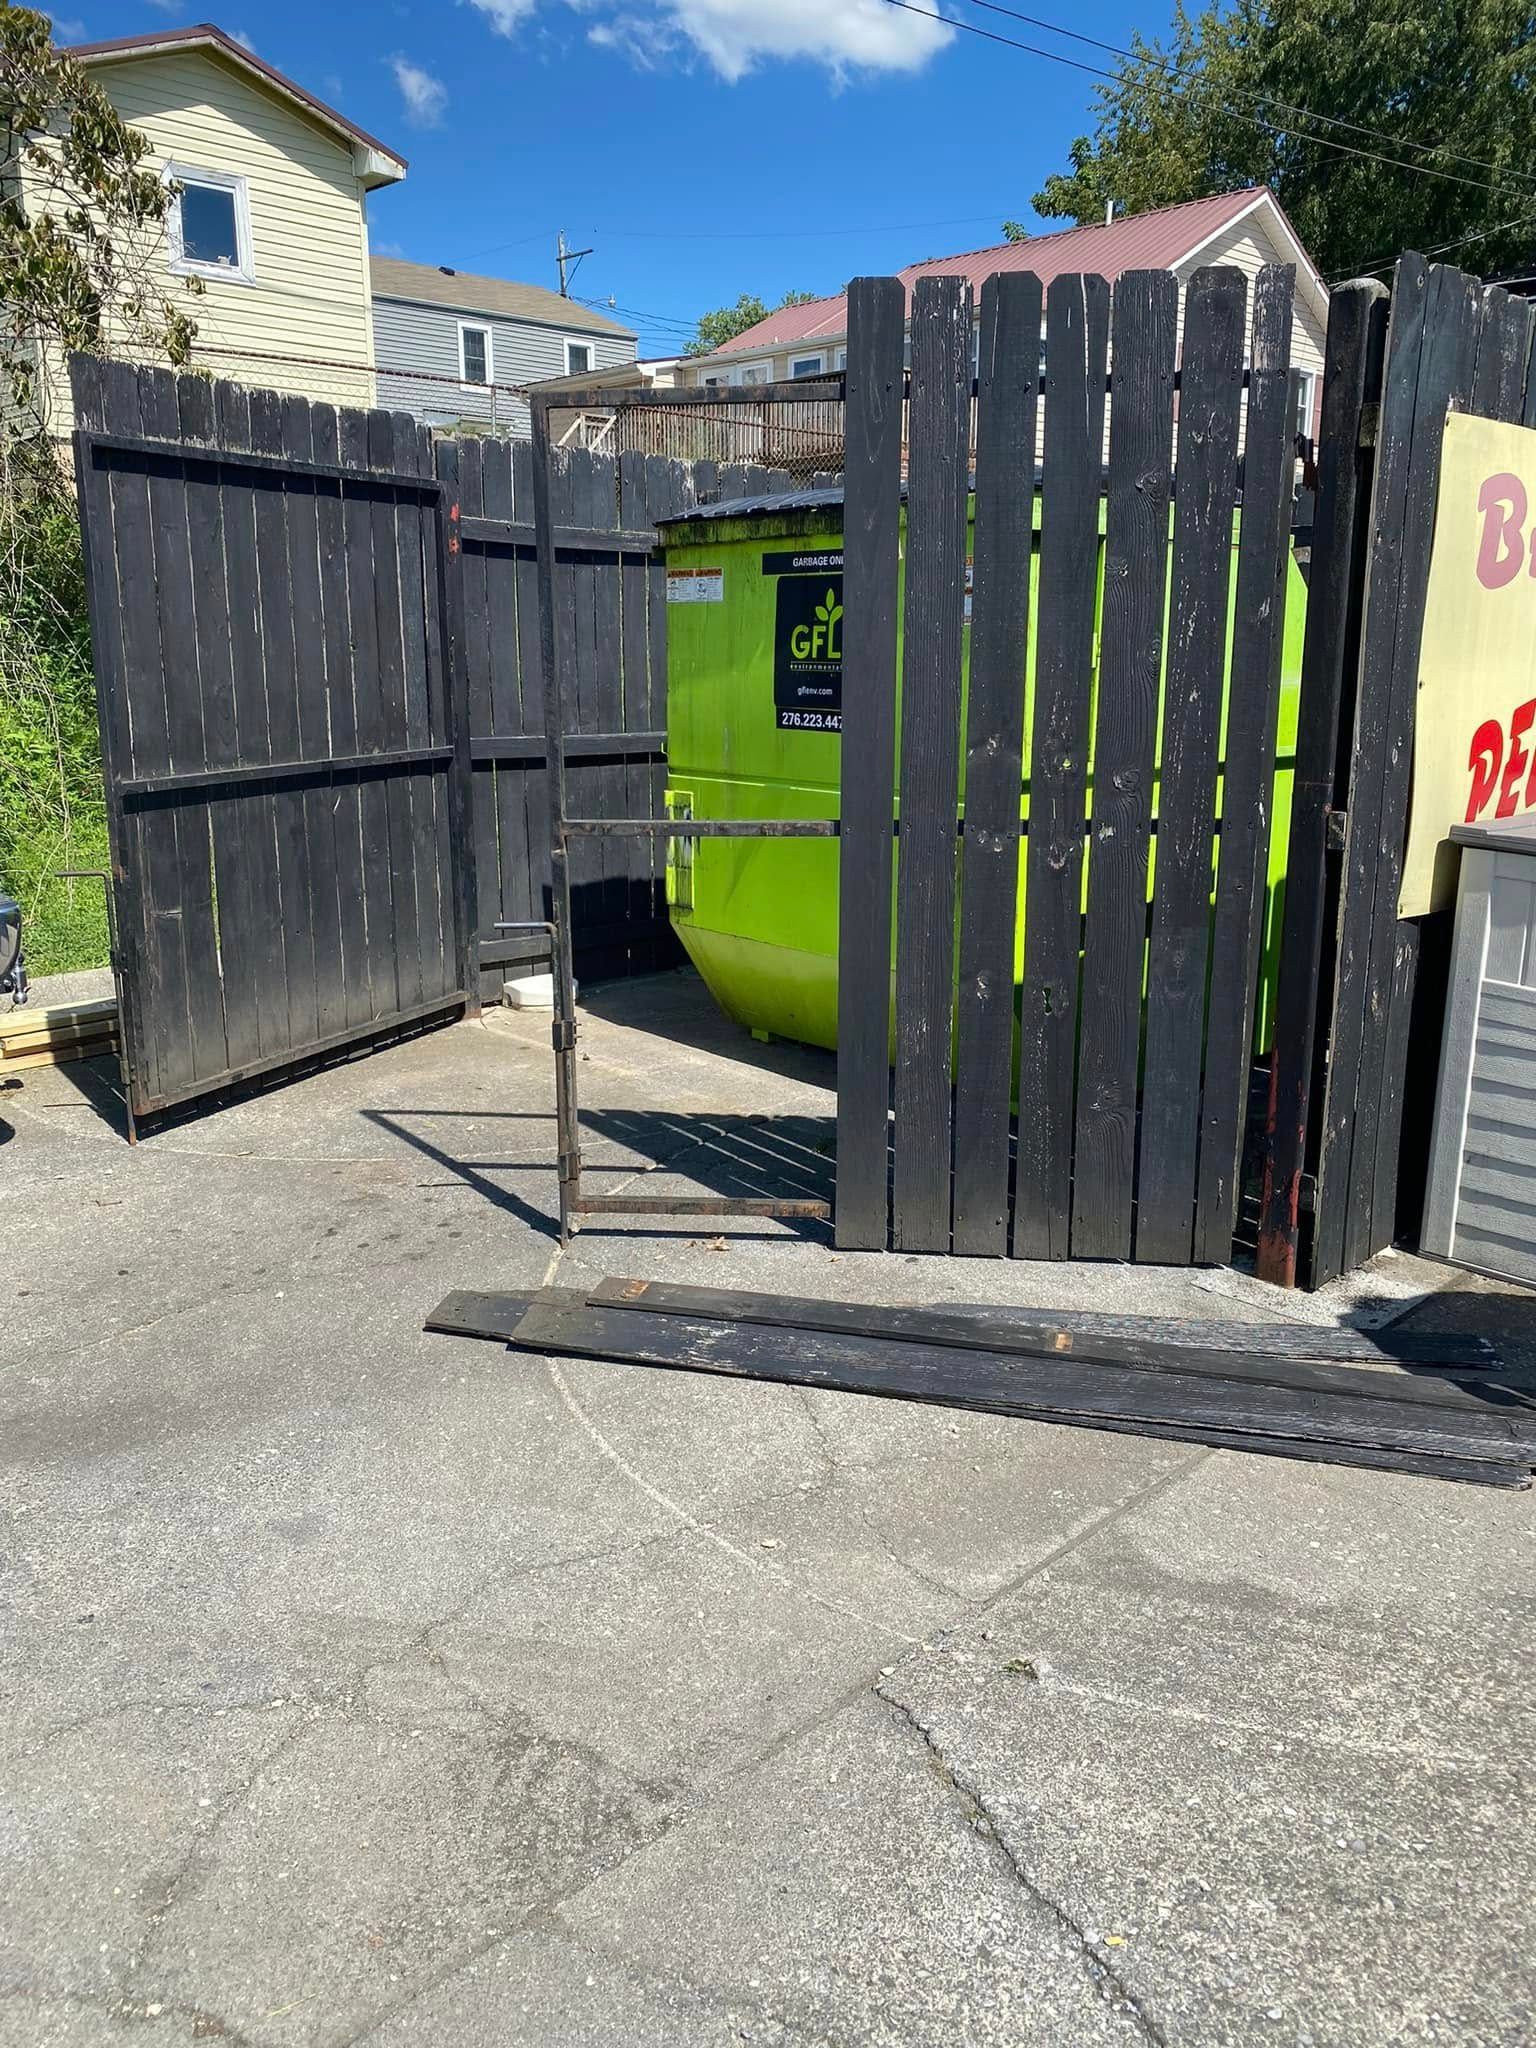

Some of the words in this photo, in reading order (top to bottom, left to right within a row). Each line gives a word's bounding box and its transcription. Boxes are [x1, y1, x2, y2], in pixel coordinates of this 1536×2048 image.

[792, 556, 829, 567] GARBAGE
[791, 624, 841, 659] GFL
[797, 686, 833, 696] gflenv.com
